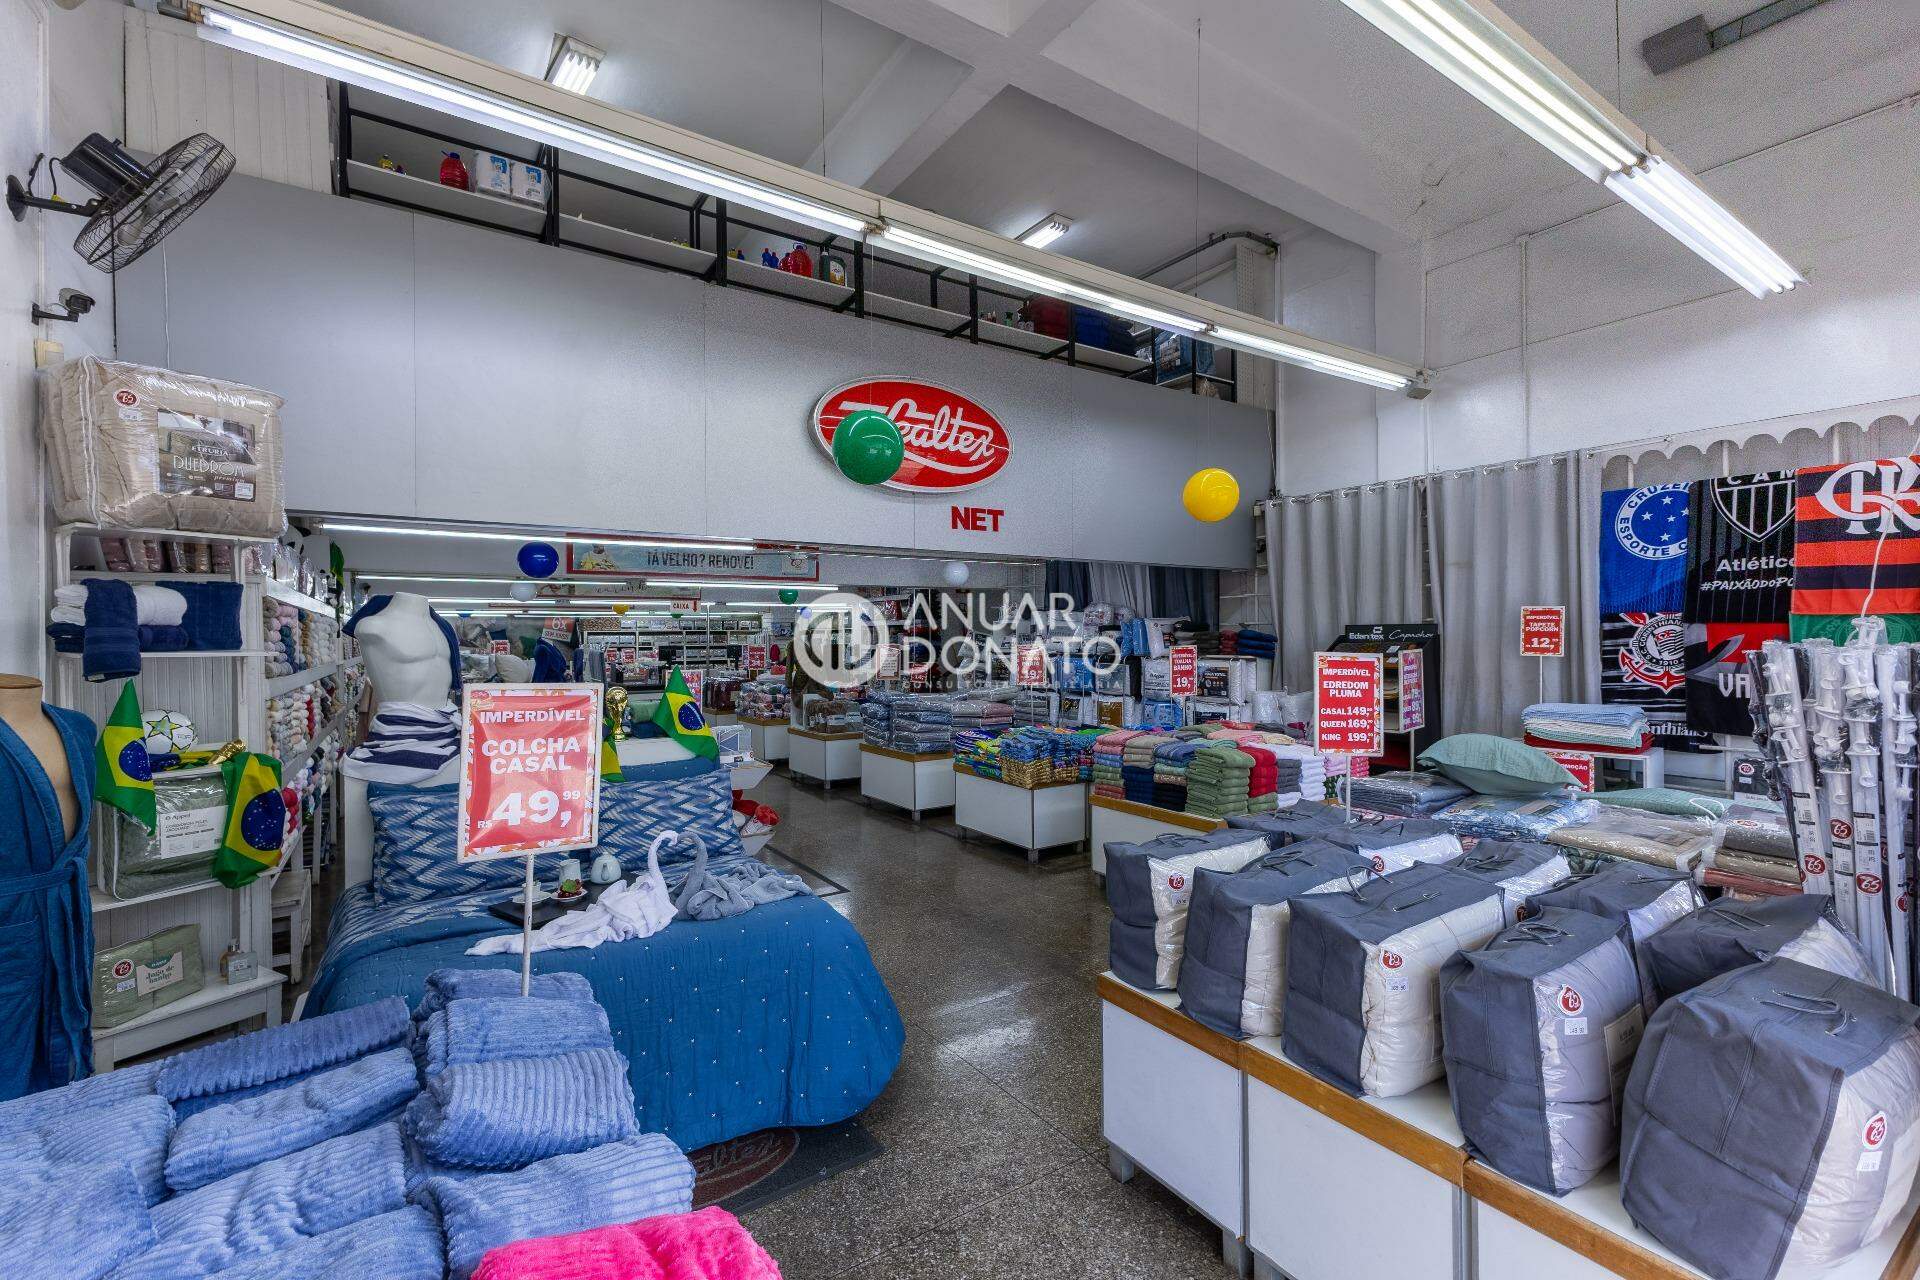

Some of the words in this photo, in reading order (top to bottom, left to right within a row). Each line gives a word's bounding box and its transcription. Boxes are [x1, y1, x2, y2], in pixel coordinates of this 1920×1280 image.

[951, 505, 1004, 532] NET
[1619, 516, 1670, 557] ESPORTE
[662, 552, 705, 568] VELHO?
[708, 554, 754, 569] RENOVE!
[1531, 637, 1558, 650] 12,
[1323, 667, 1371, 677] IMPERDÍVEL
[1176, 676, 1193, 689] 19,
[1323, 680, 1369, 689] EDREDOM
[1329, 689, 1362, 697] PLUMA
[480, 708, 585, 724] IMPERDÍVEL
[1320, 720, 1346, 728] QUEEN
[1321, 733, 1341, 741] KING
[482, 736, 581, 757] COLCHA
[490, 755, 572, 775] CASAL
[1834, 824, 1848, 835] 65
[1808, 859, 1821, 870] 65
[1862, 879, 1880, 889] 65
